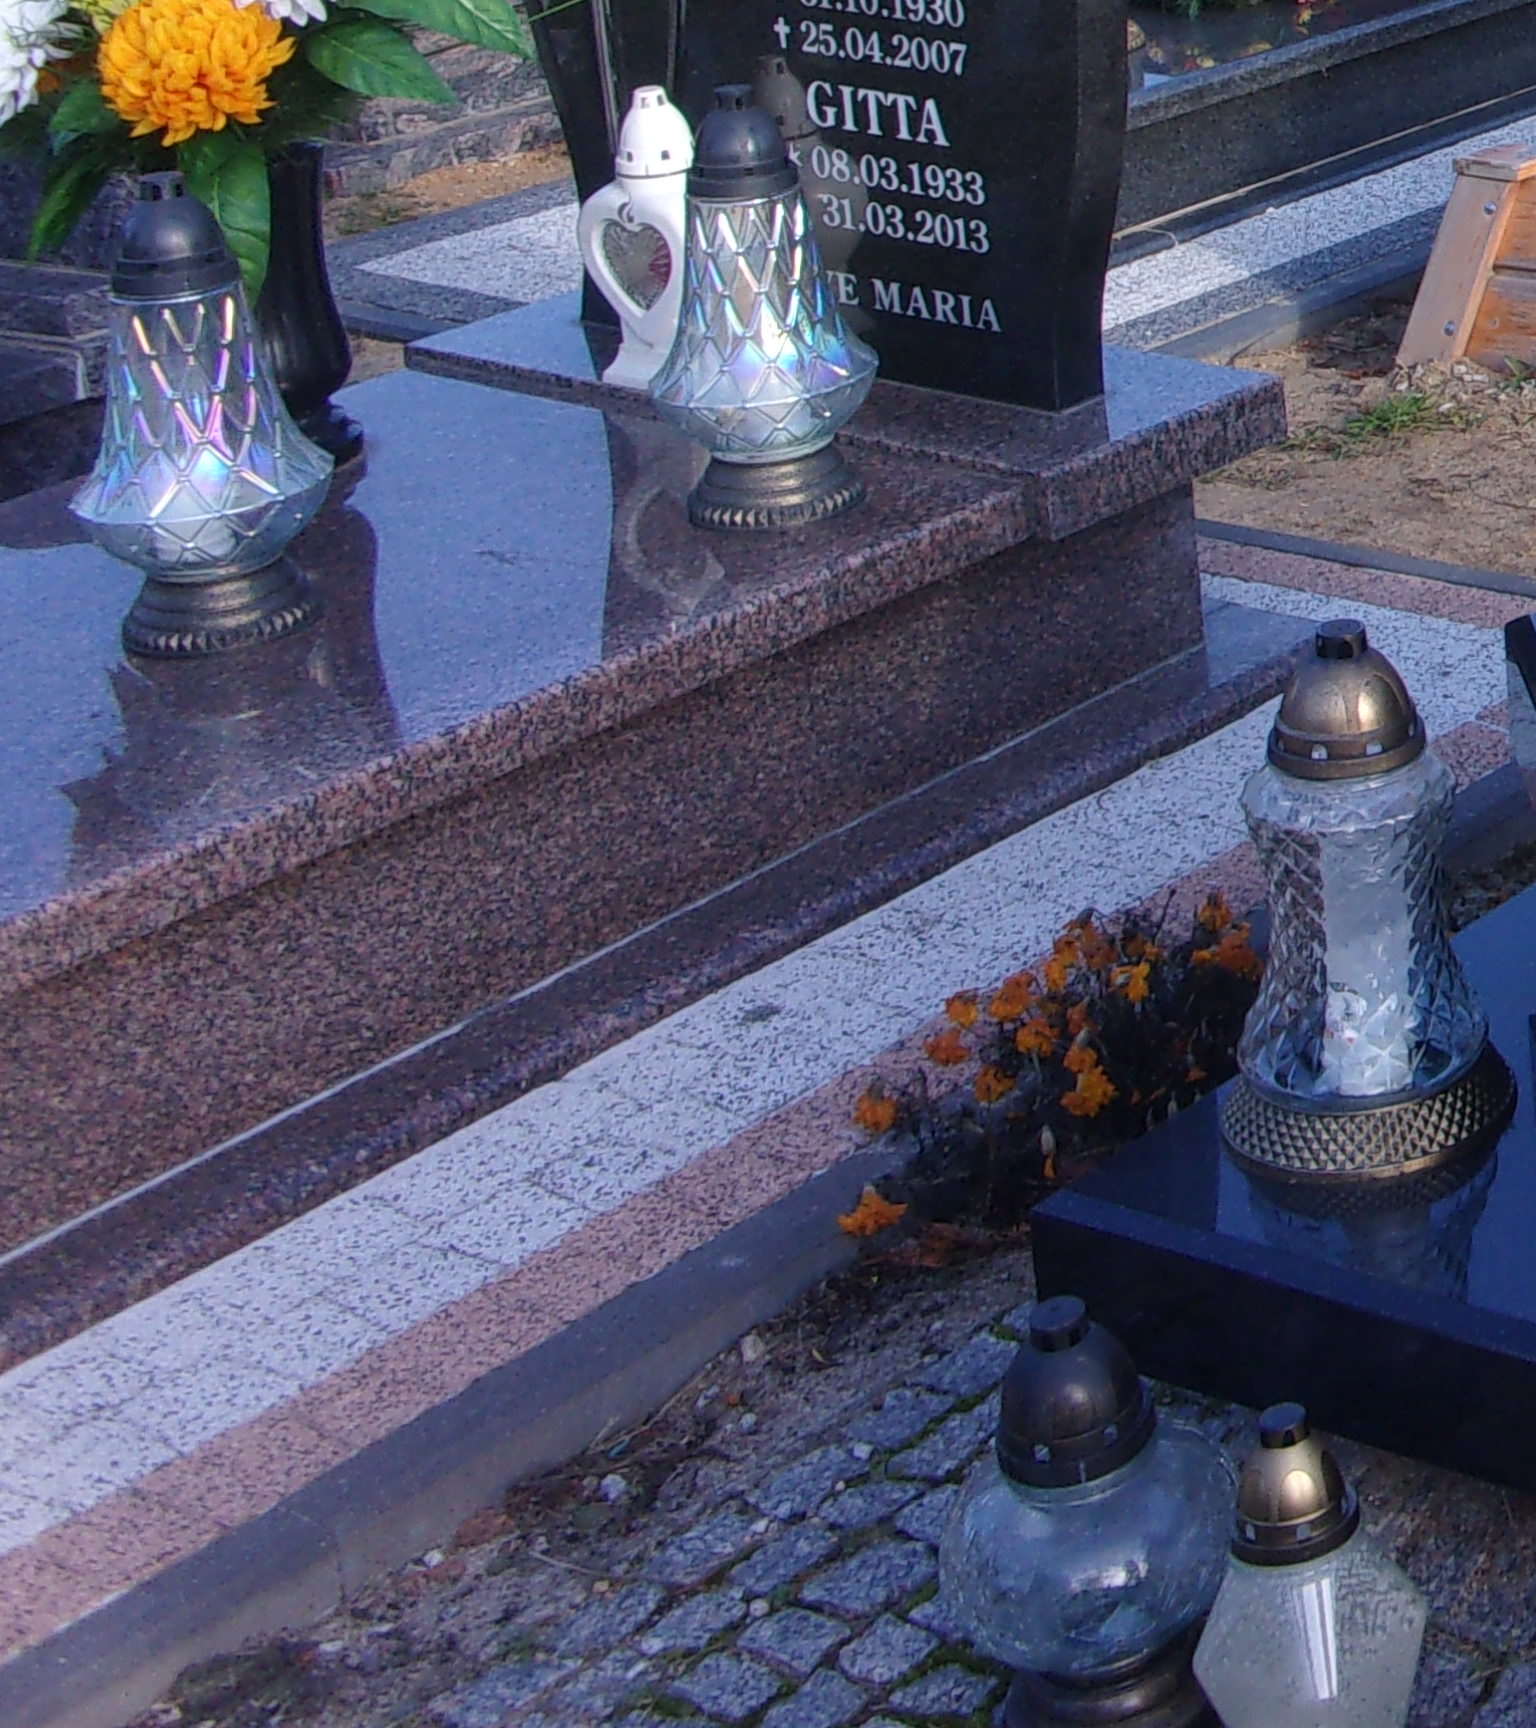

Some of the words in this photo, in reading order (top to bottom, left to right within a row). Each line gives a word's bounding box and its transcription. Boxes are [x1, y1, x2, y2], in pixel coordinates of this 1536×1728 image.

[800, 20, 968, 76] 25.04.2007
[806, 80, 951, 148] GITTA
[811, 144, 986, 206] 08.03.1933
[821, 193, 990, 254] 31.03.2013
[871, 278, 1002, 332] MARIA
